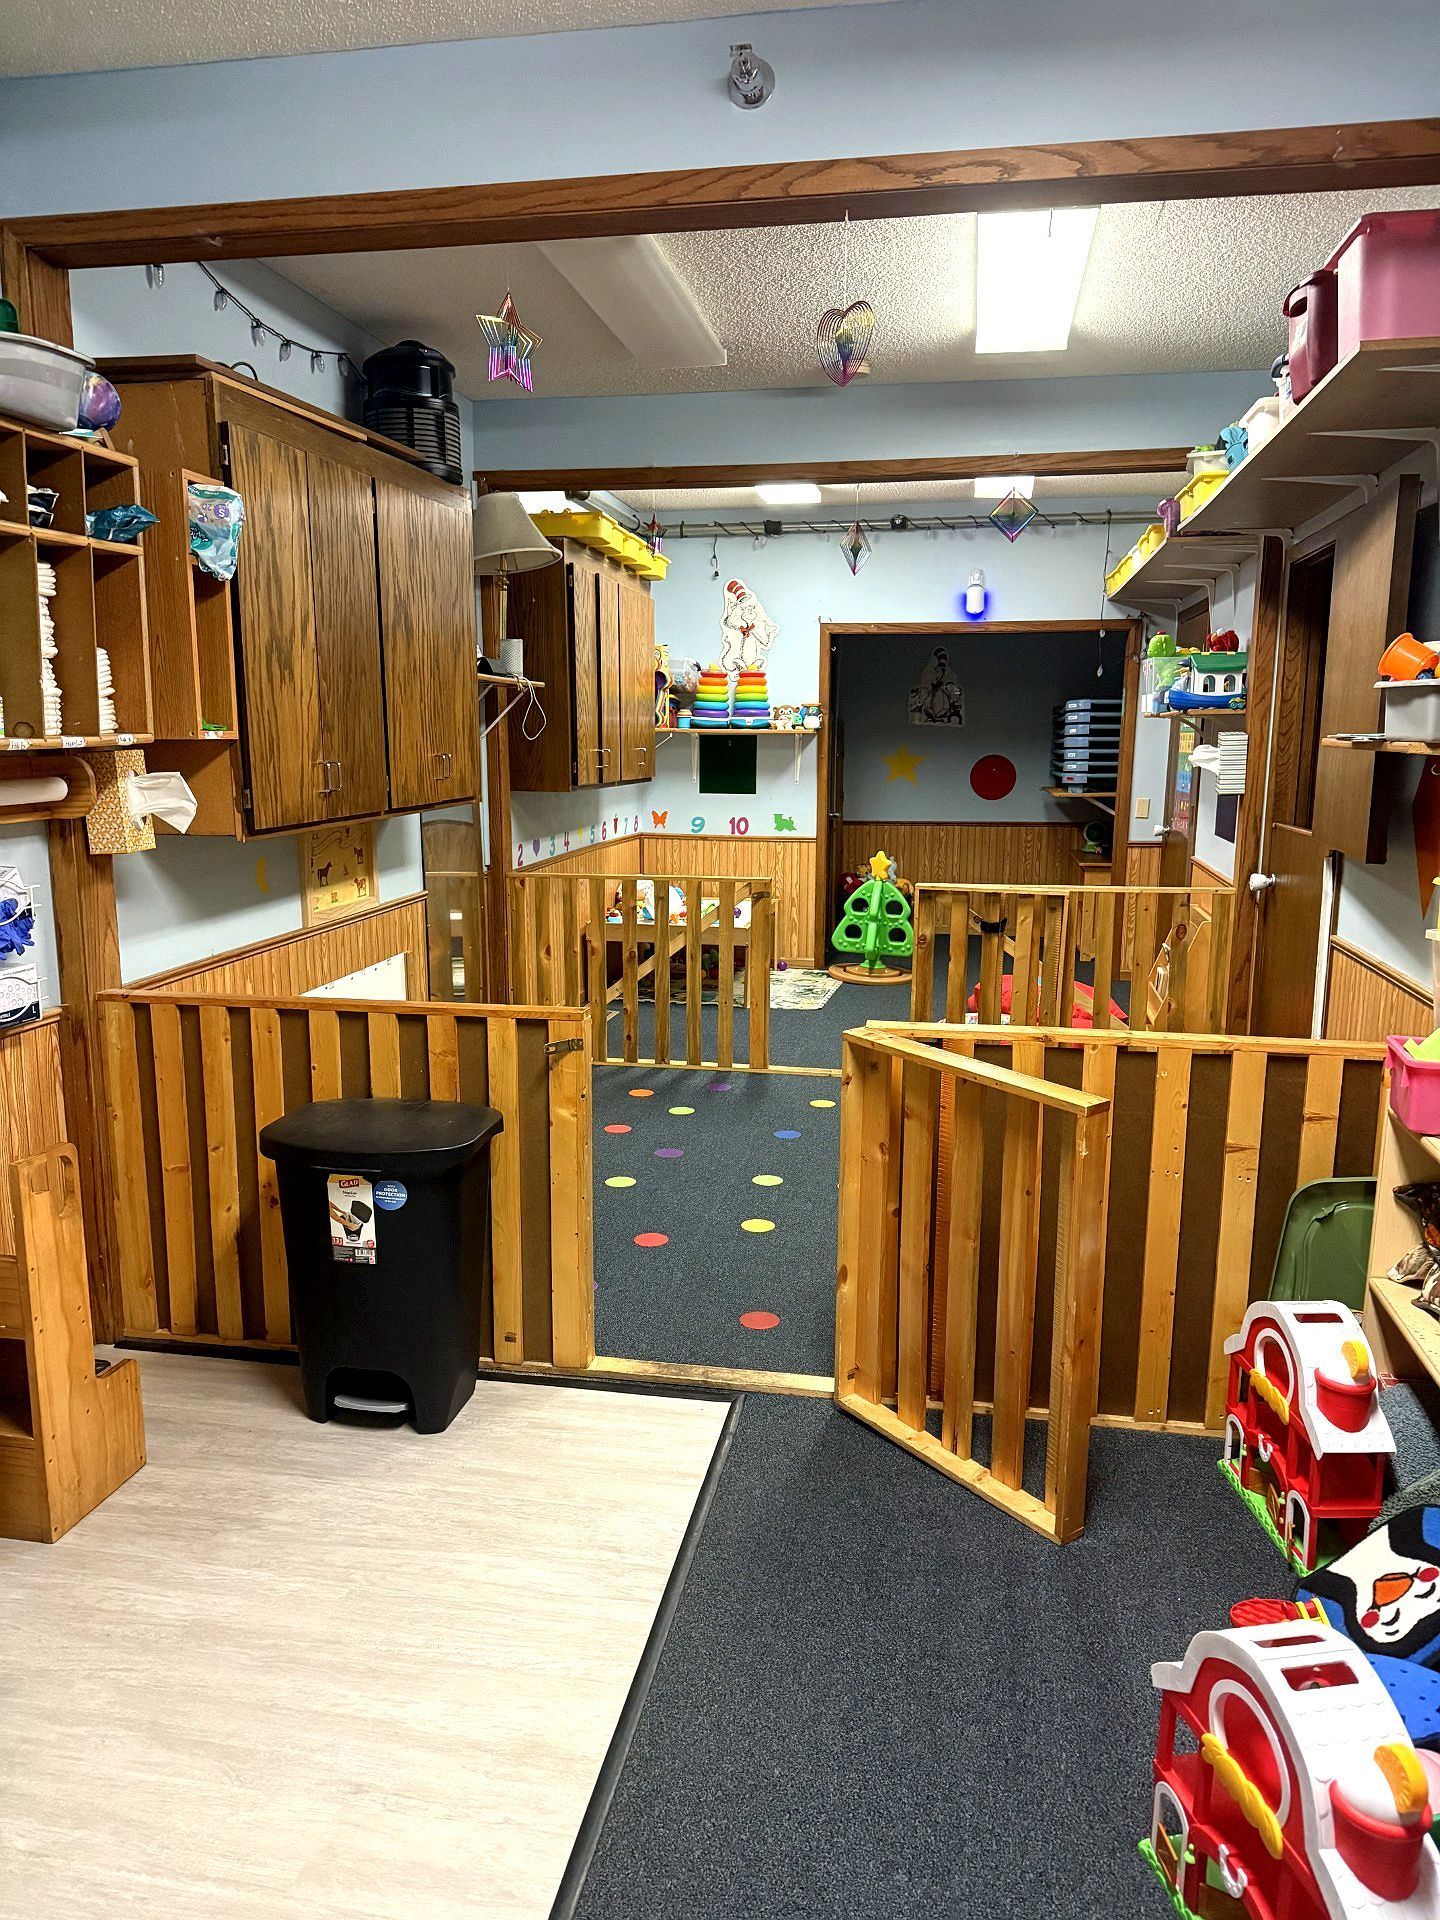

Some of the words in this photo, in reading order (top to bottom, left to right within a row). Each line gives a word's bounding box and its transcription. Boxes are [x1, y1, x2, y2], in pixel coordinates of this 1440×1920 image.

[218, 508, 225, 517] S
[691, 816, 705, 834] 9
[729, 816, 749, 835] 10
[517, 843, 523, 867] 2
[549, 835, 555, 856] 3
[564, 831, 570, 851] 4
[590, 824, 595, 843] 5
[601, 821, 607, 840] 6
[624, 817, 629, 834] 7
[633, 815, 639, 832] 8
[32, 1006, 36, 1014] L
